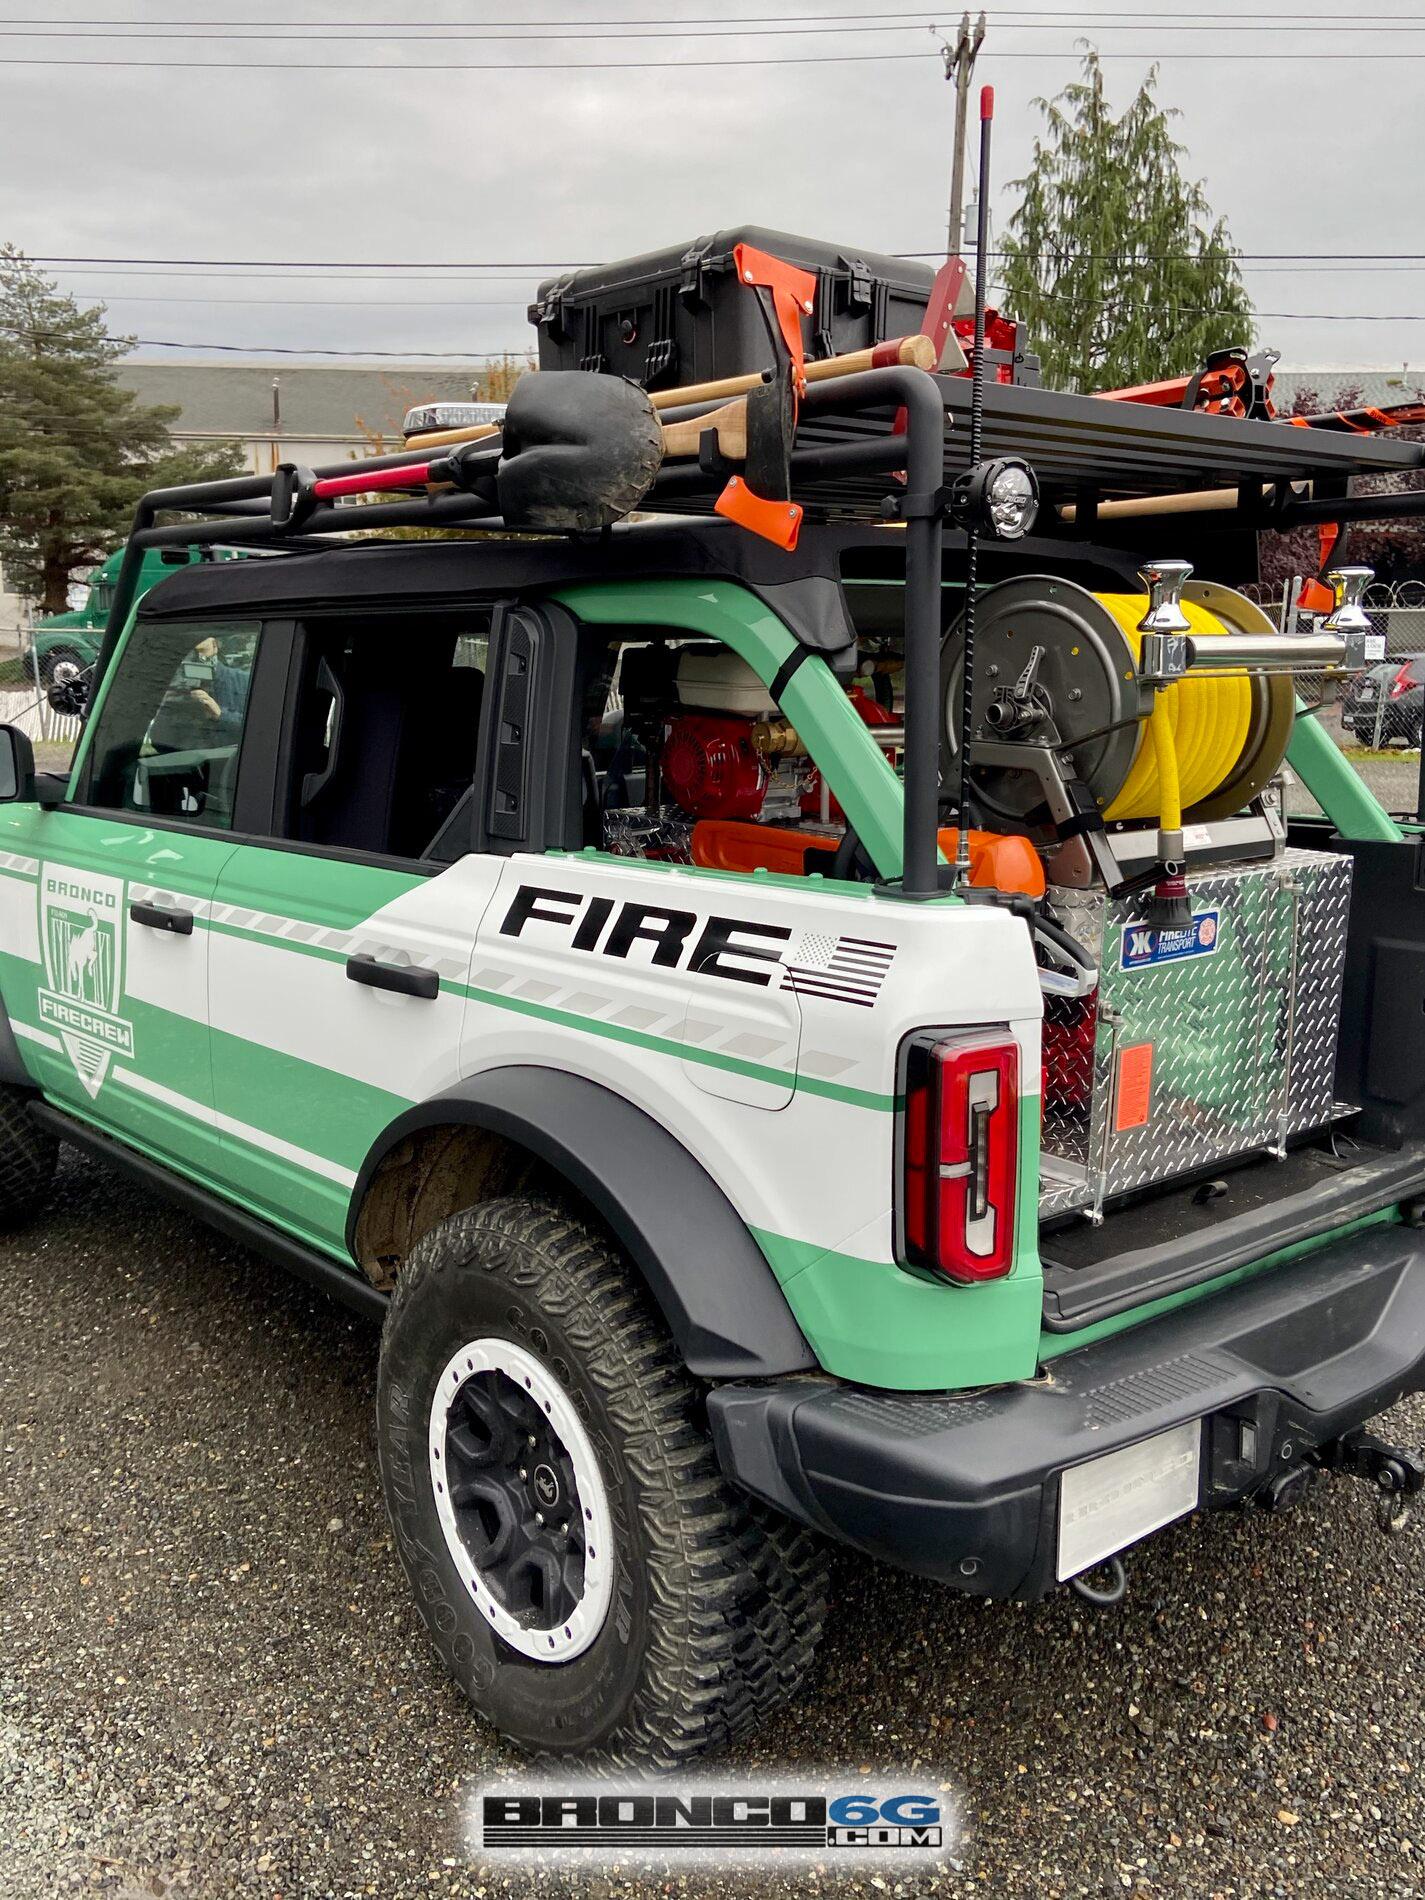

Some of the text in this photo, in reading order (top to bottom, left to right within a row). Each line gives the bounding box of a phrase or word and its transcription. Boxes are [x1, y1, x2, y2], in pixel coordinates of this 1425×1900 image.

[47, 878, 116, 909] BRONCO
[498, 884, 793, 987] FIRE
[1157, 936, 1196, 954] TRANSPORT
[42, 998, 130, 1048] FIRECREW
